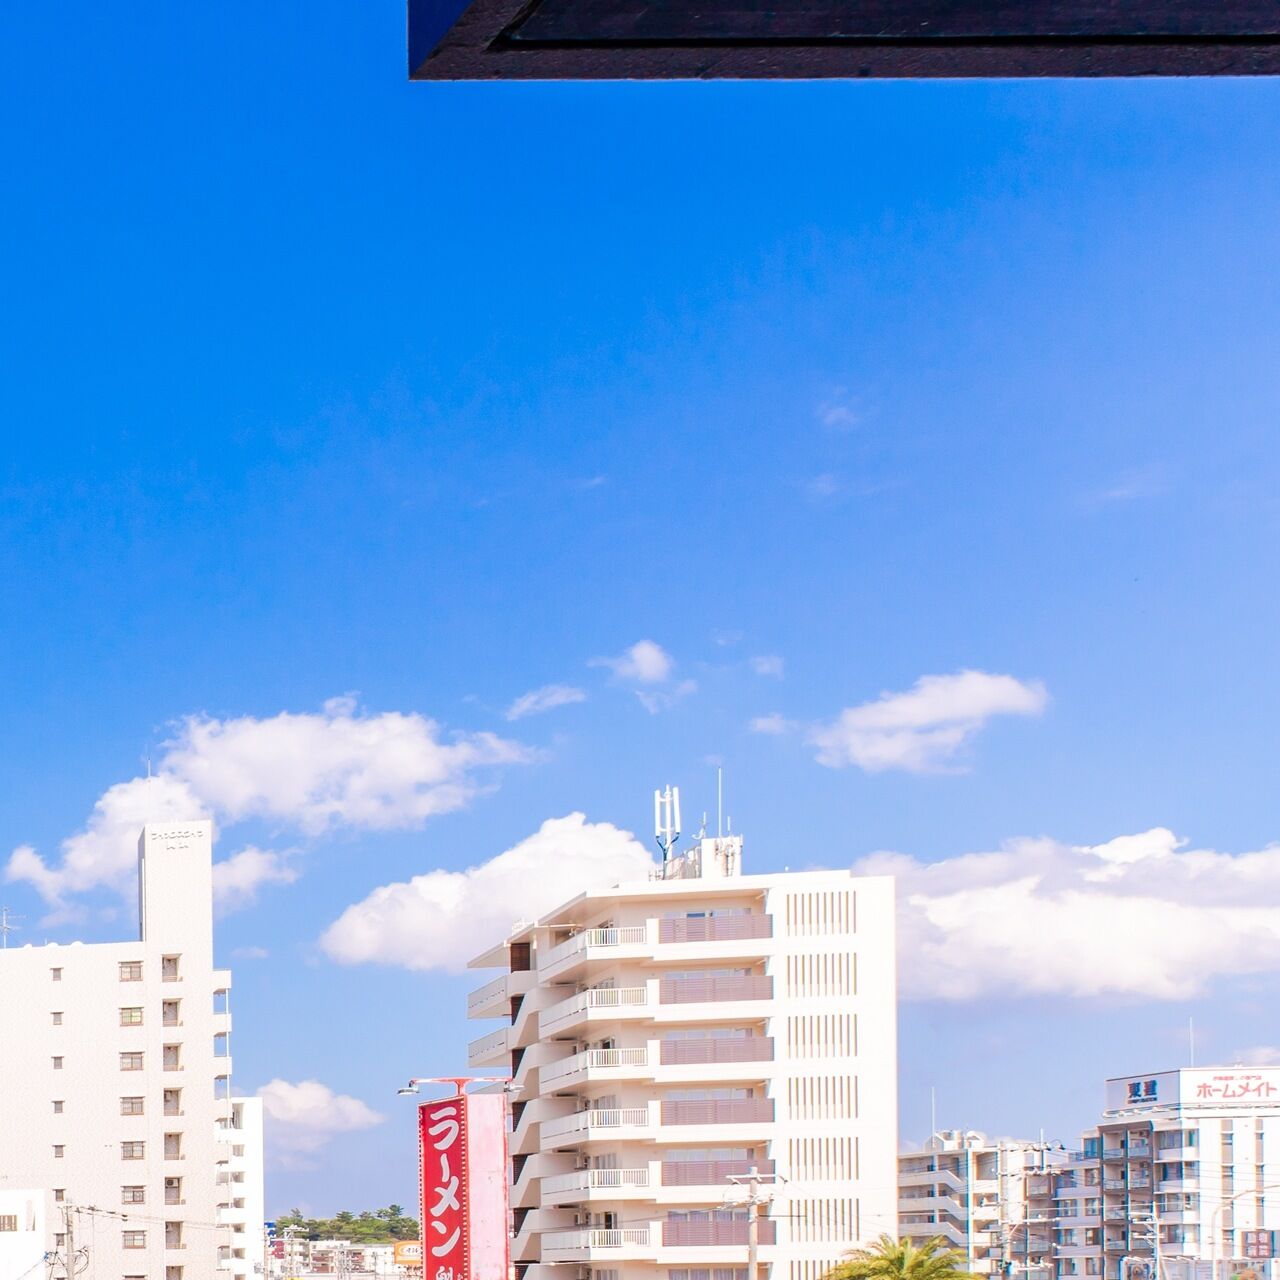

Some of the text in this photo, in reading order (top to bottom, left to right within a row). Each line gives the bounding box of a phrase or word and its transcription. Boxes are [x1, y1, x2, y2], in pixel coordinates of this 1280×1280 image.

[1196, 1082, 1277, 1099] ホームメイト
[428, 1106, 461, 1258] ラーメン
